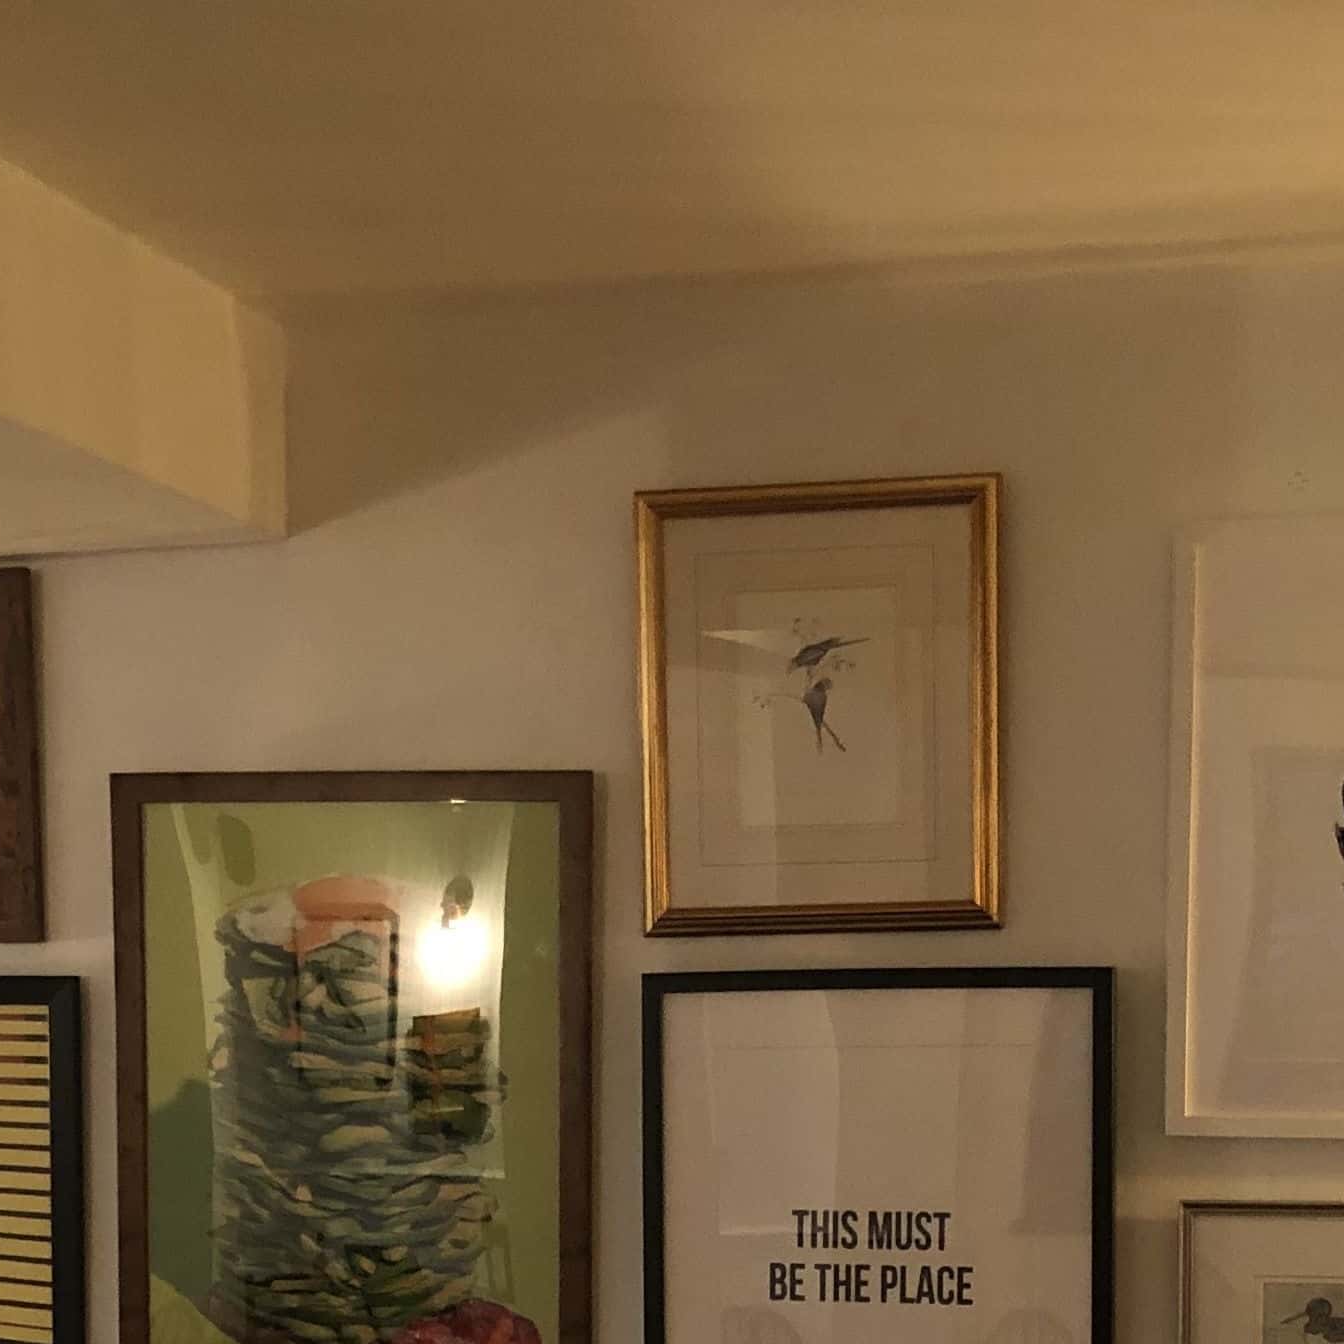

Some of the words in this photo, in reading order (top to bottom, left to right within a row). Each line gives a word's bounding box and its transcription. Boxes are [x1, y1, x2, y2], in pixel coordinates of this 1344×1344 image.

[792, 1209, 858, 1250] THIS
[867, 1211, 952, 1252] MUST
[769, 1262, 806, 1302] BE
[814, 1263, 872, 1303] THE
[880, 1264, 974, 1306] PLACE
